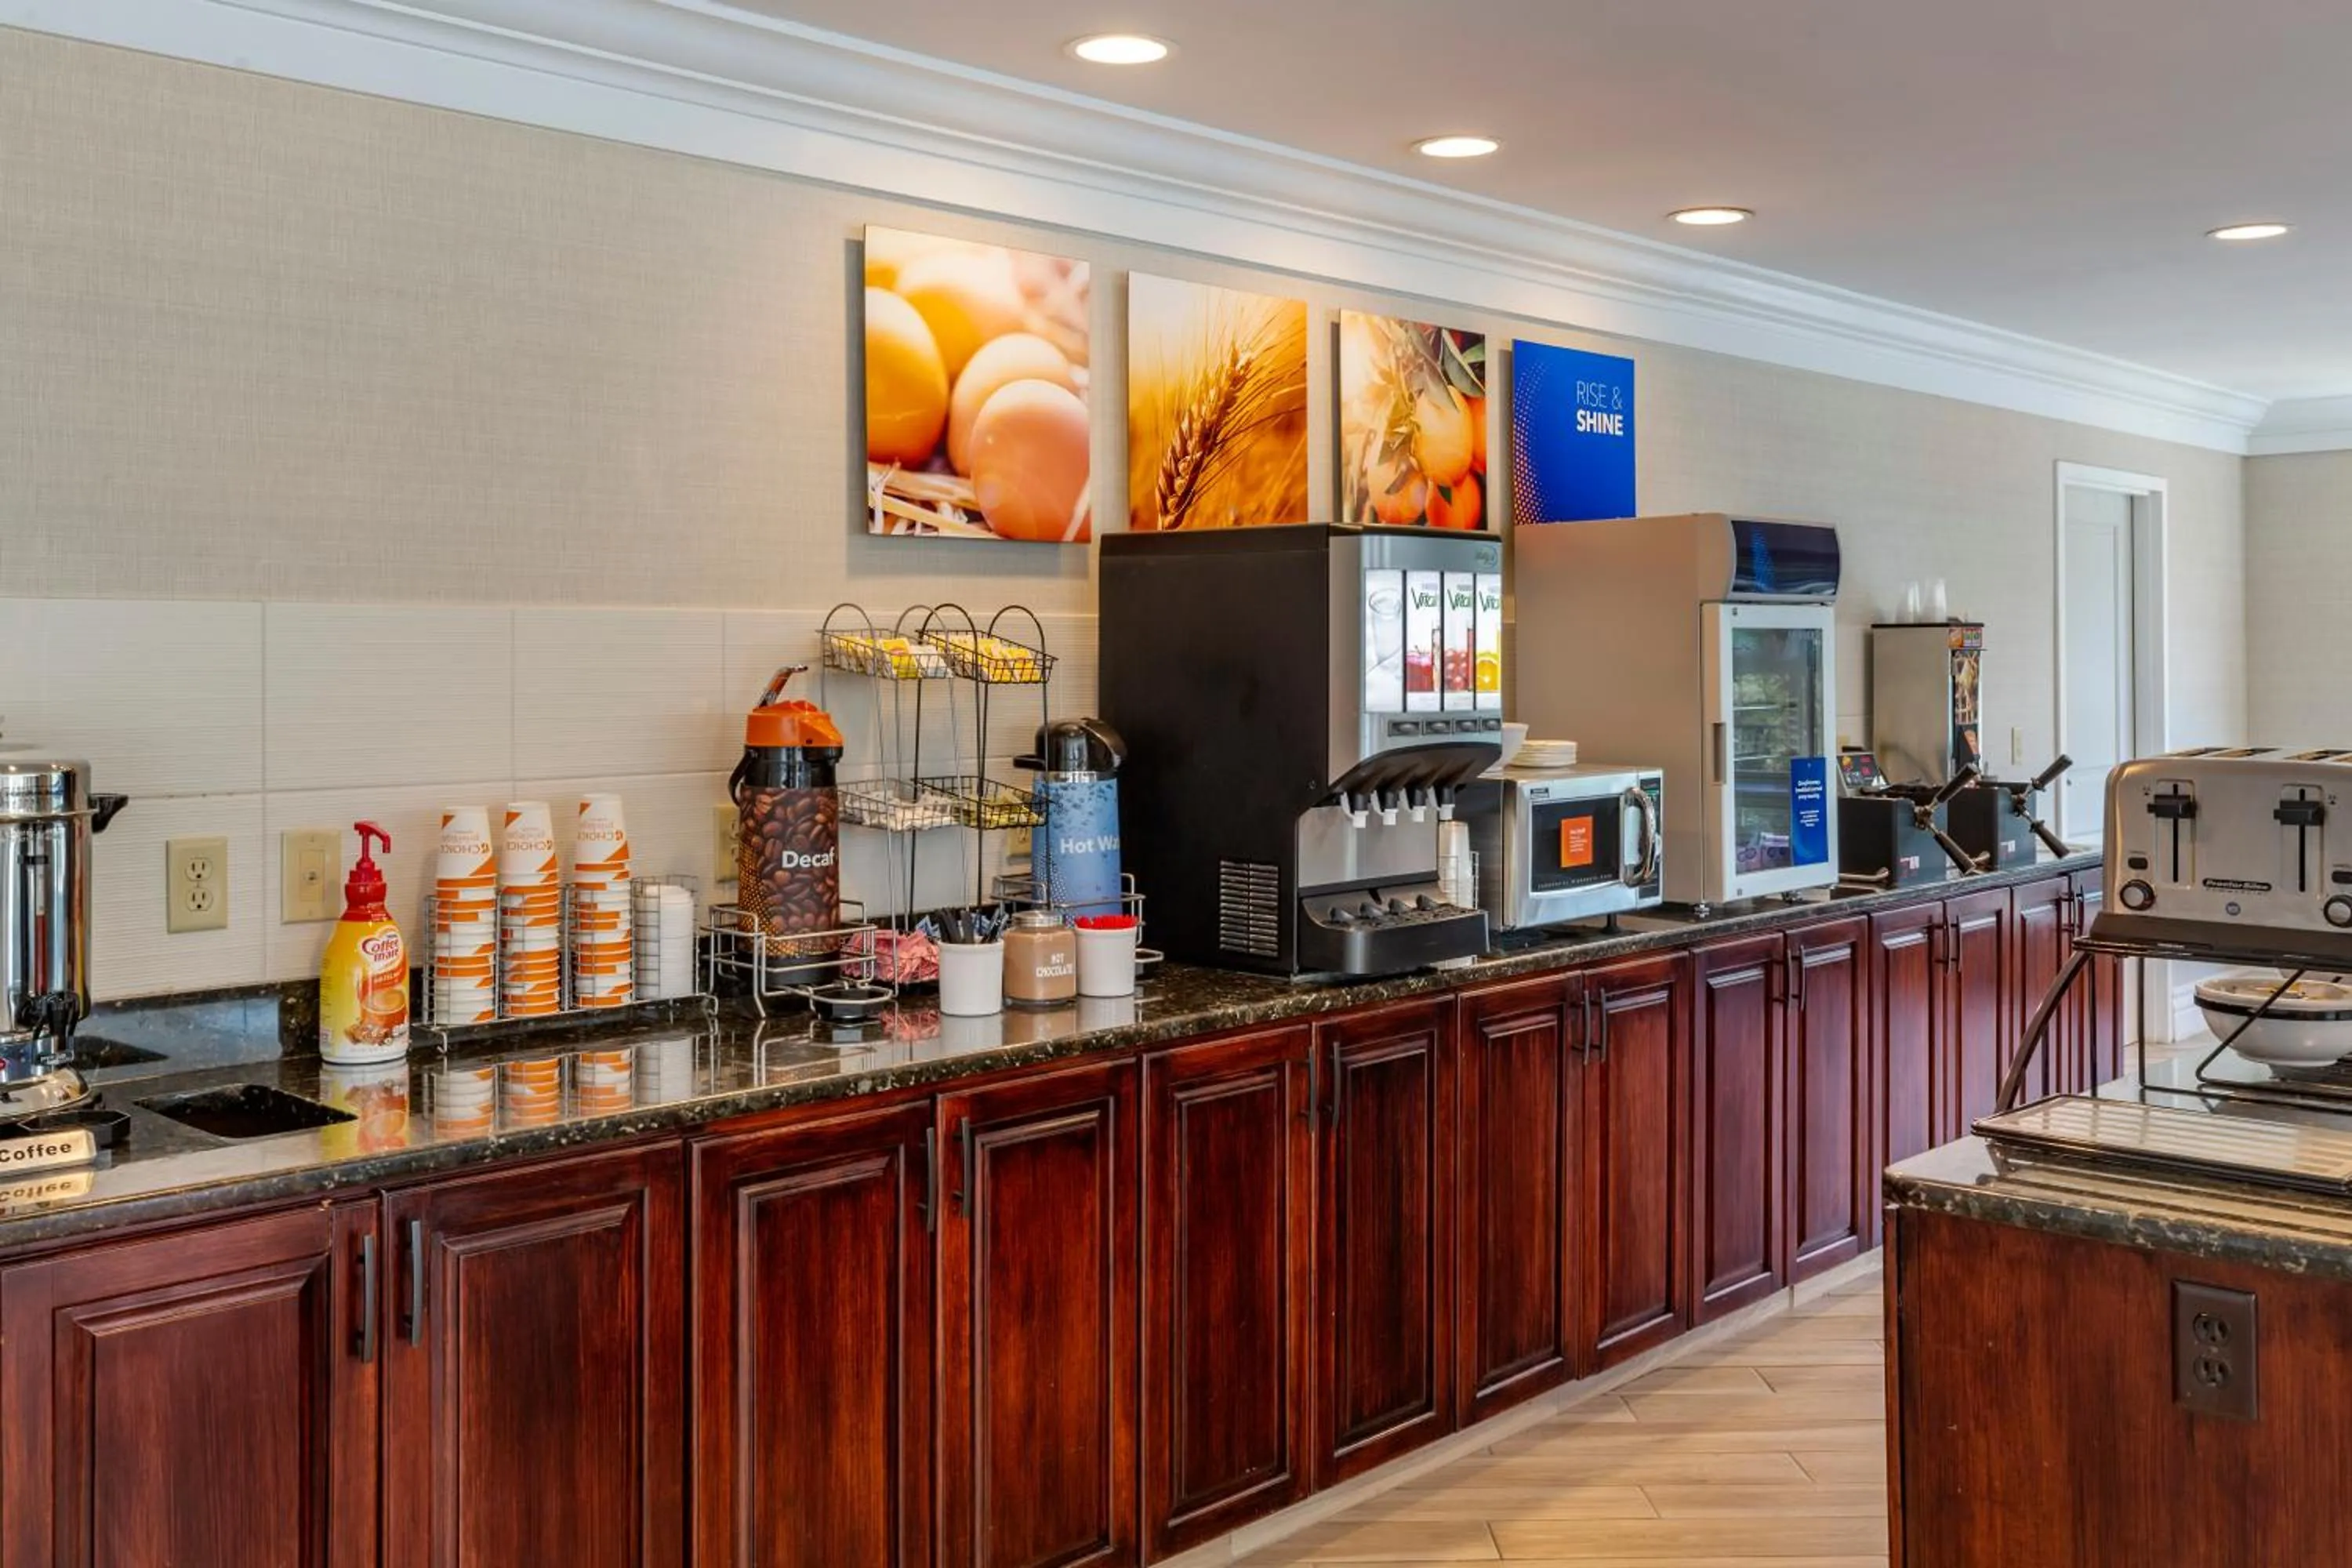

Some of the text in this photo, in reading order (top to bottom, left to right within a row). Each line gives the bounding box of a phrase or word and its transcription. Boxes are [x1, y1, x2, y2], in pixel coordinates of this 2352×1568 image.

[1577, 380, 1623, 410] RISE &
[1577, 408, 1624, 436] SHINE
[782, 846, 835, 869] Decaf
[1060, 837, 1094, 855] Hot
[0, 1143, 72, 1163] Coffee
